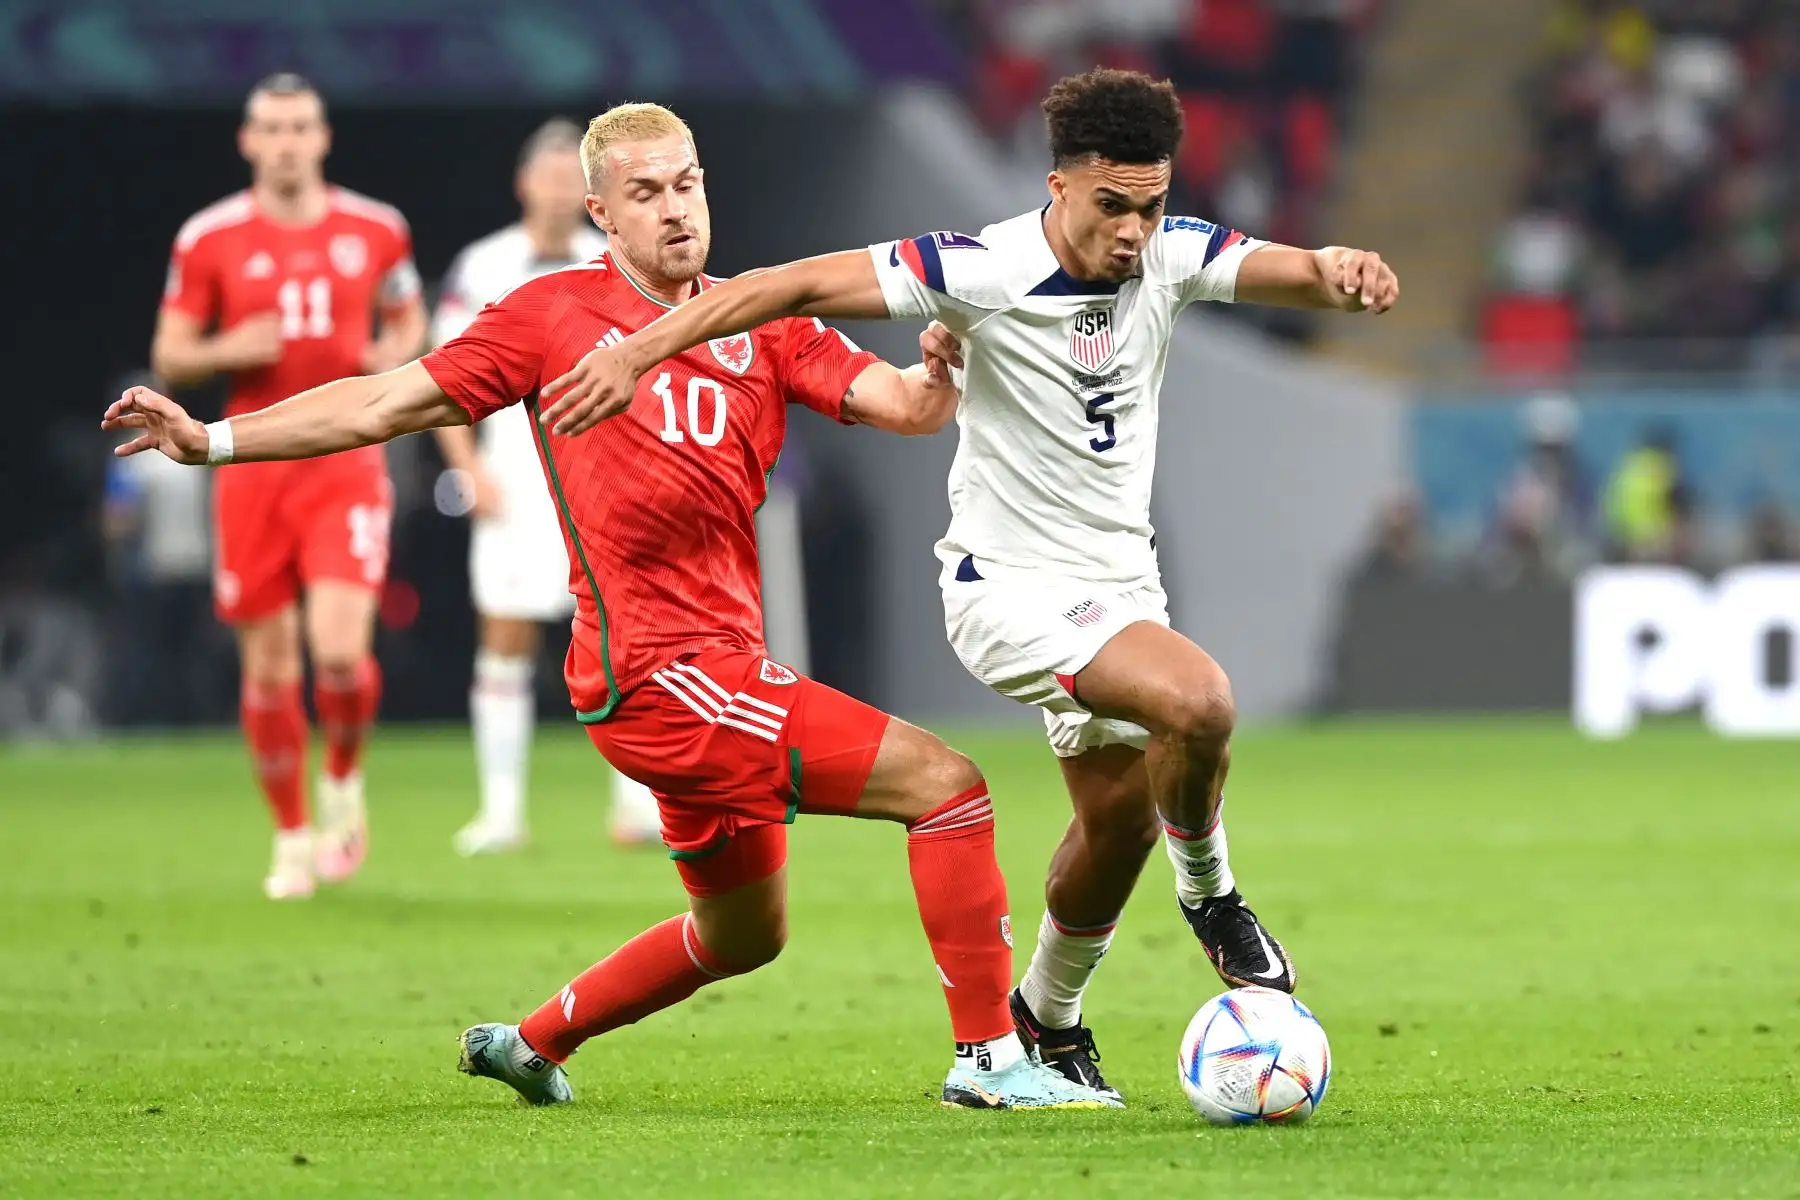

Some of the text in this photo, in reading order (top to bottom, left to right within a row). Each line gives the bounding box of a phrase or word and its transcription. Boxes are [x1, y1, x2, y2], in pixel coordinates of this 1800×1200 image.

[277, 277, 333, 339] 11
[1074, 311, 1108, 337] USA
[651, 372, 727, 446] 10
[1086, 393, 1116, 453] 5
[1066, 600, 1093, 617] USA
[1573, 563, 1800, 739] PO
